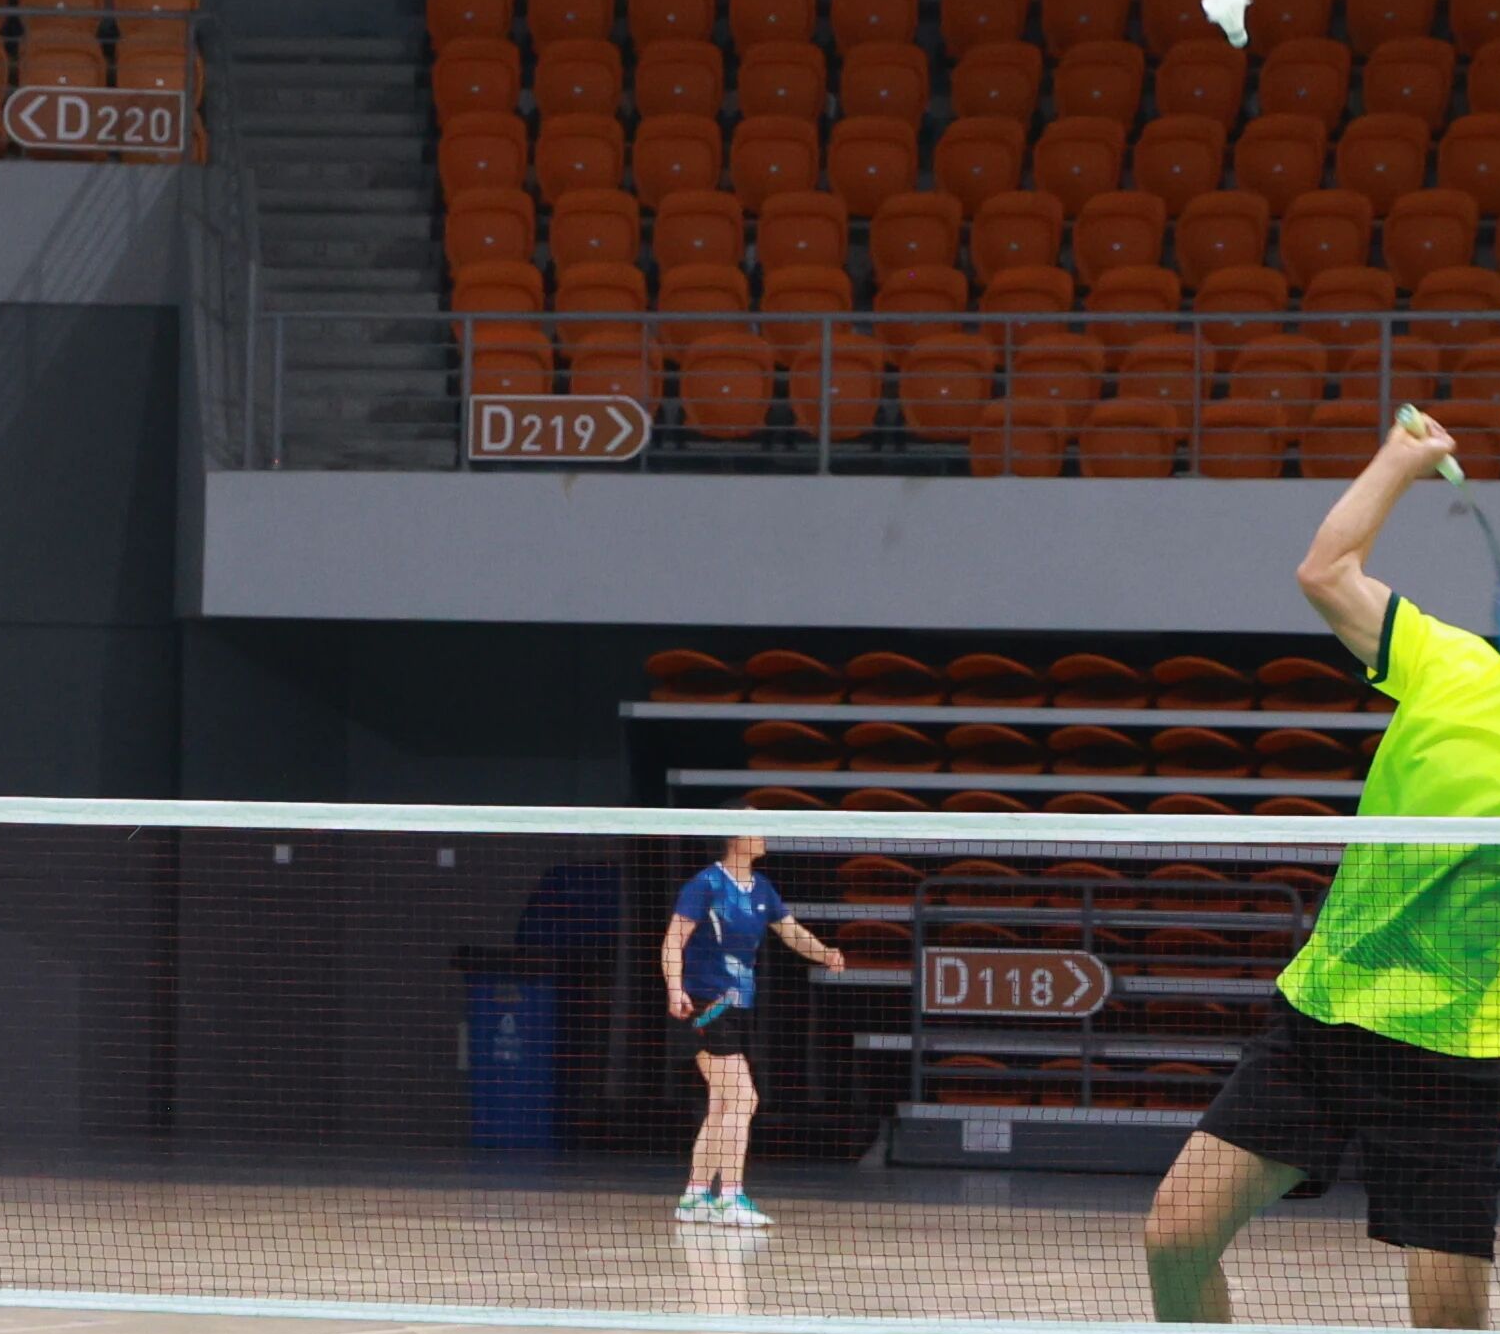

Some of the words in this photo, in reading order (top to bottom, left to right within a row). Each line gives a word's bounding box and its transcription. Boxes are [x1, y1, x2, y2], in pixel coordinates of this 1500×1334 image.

[58, 96, 172, 143] D220
[482, 405, 596, 453] D219
[935, 957, 1054, 1007] D118
